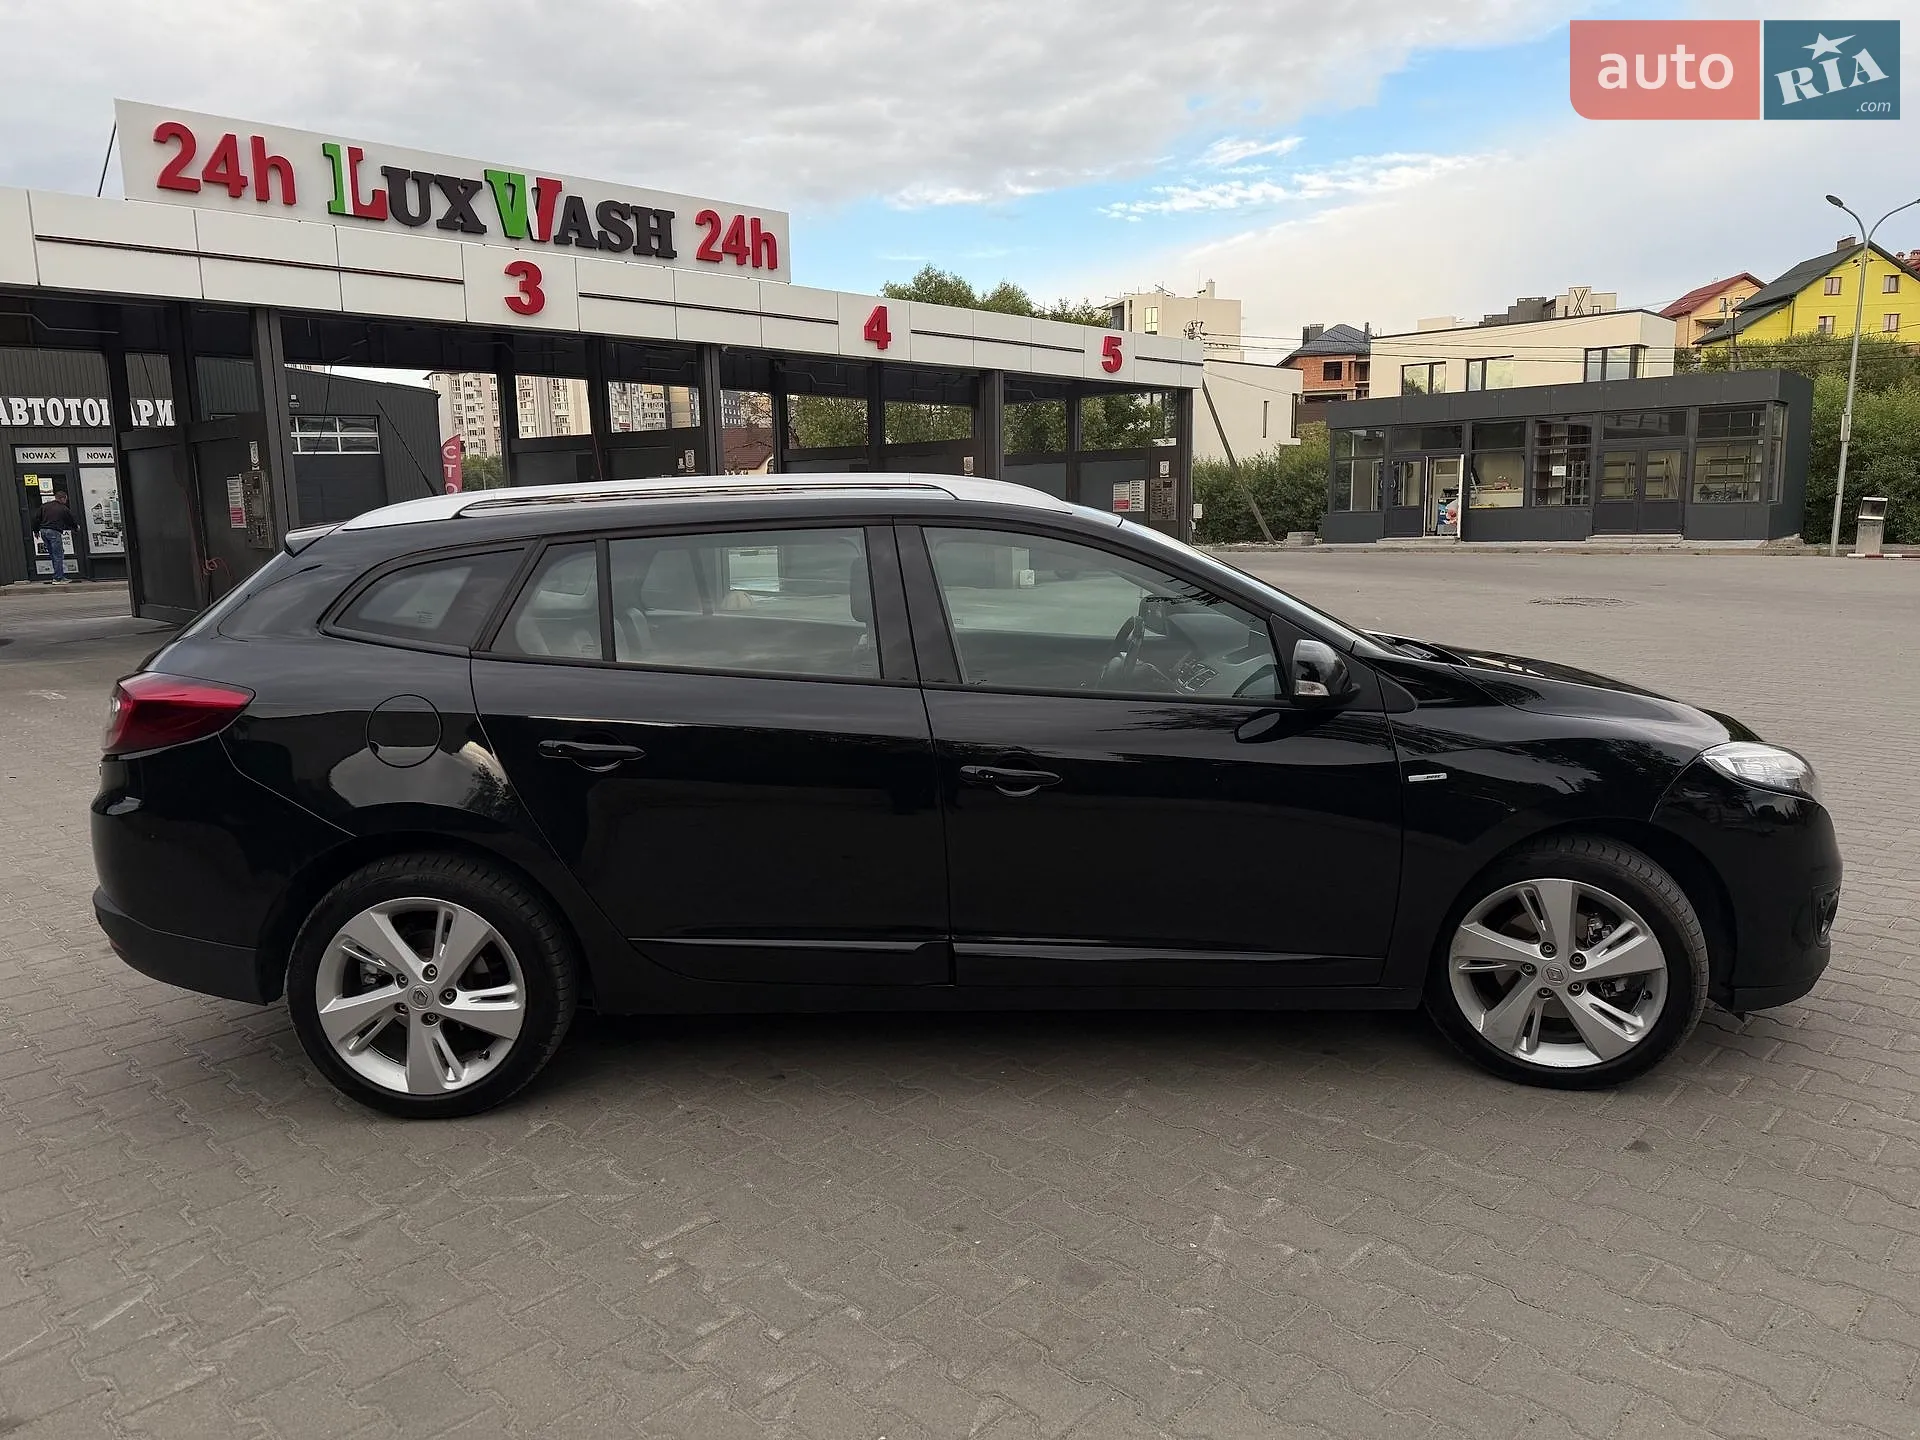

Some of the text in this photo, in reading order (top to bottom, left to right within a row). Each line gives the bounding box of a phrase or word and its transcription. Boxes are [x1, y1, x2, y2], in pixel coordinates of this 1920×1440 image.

[152, 121, 297, 206] 24h
[695, 209, 779, 270] 24h
[504, 260, 546, 316] 3
[864, 305, 892, 350] 4
[1101, 336, 1123, 373] 5
[22, 452, 56, 460] NOWAX
[86, 452, 114, 460] NOWA
